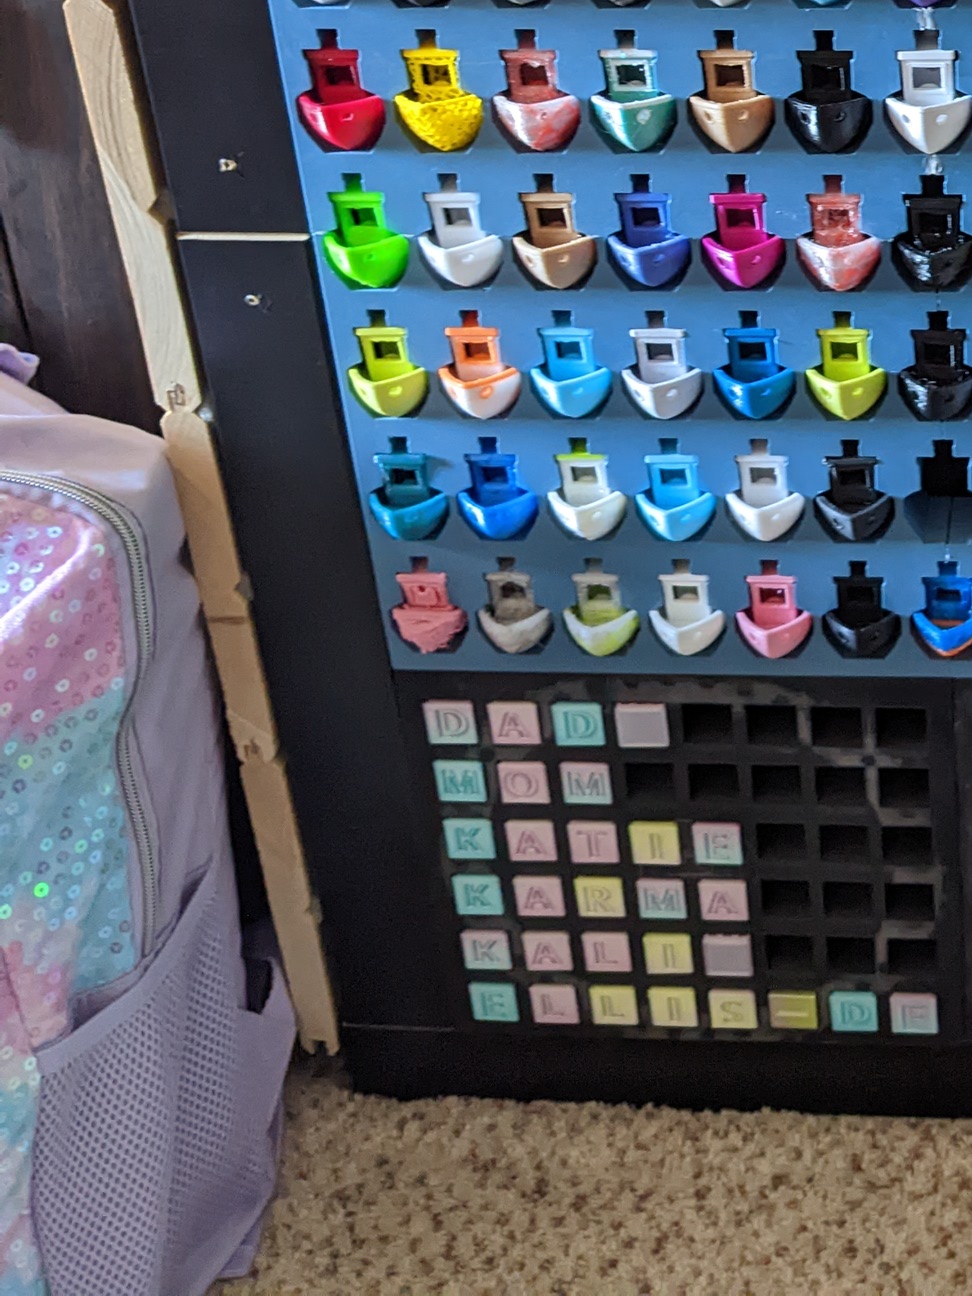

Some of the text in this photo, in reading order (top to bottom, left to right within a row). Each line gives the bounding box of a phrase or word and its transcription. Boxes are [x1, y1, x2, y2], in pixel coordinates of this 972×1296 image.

[435, 709, 599, 739] DAD
[441, 769, 606, 797] MOM
[453, 827, 731, 860] KATIE
[464, 883, 739, 914] KARMA
[472, 939, 678, 968] KALI
